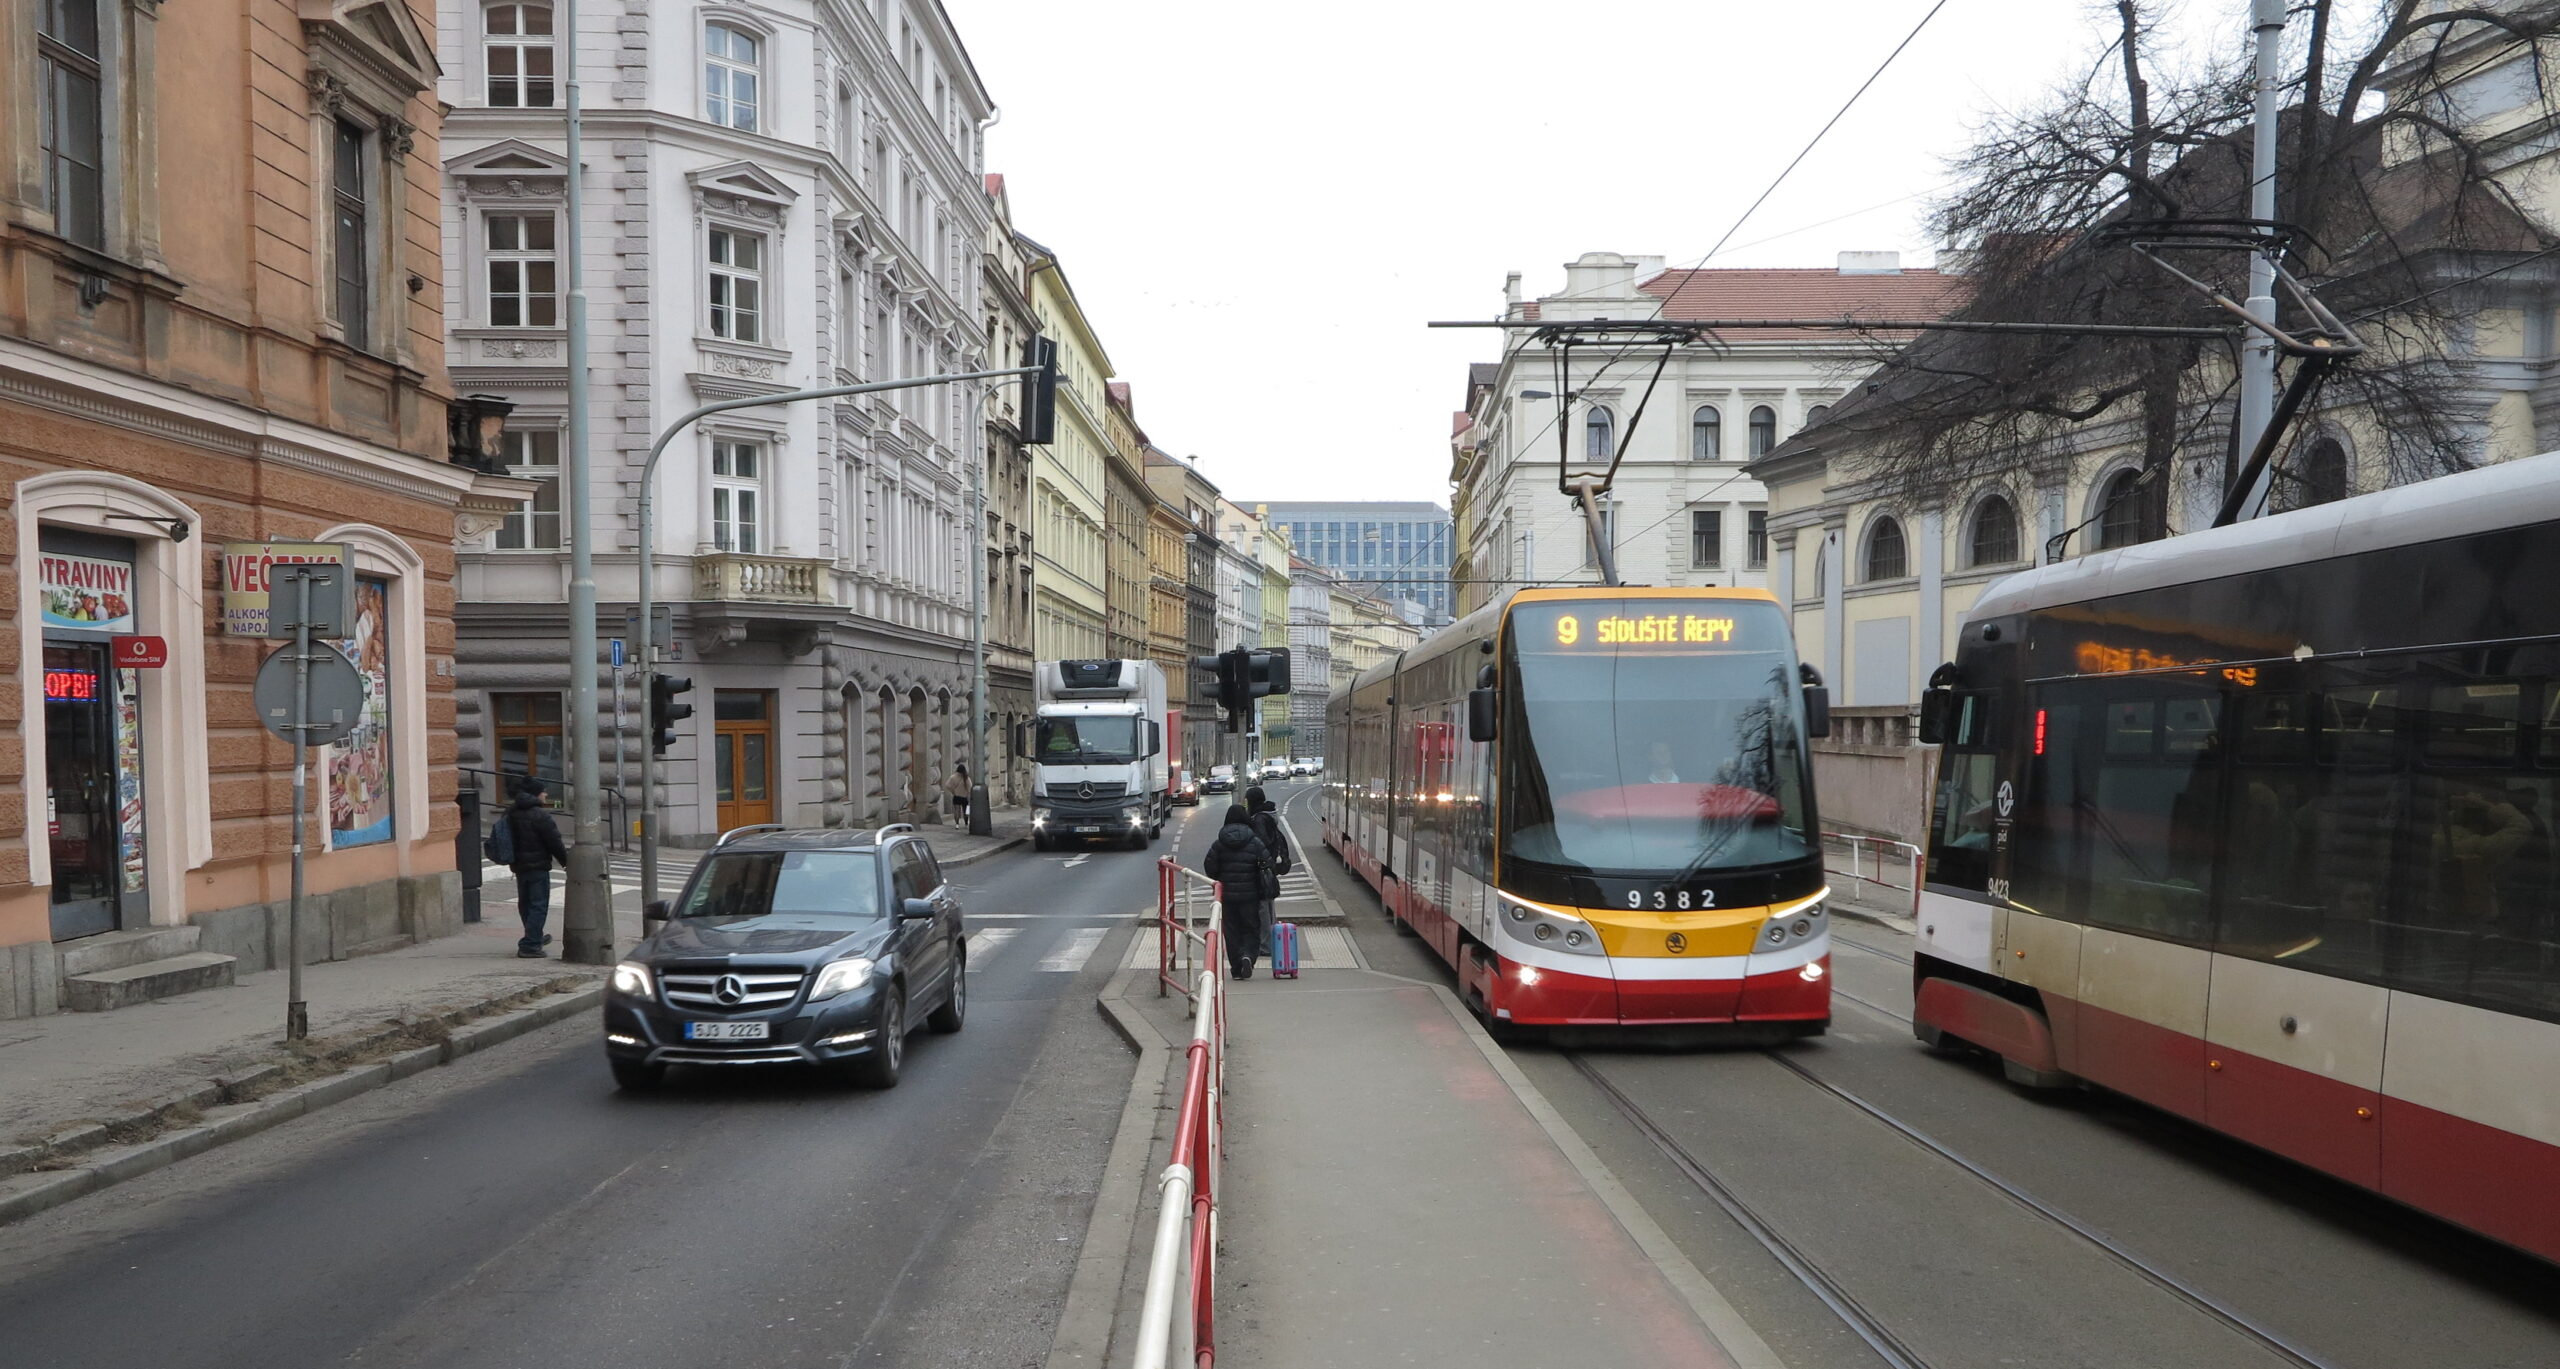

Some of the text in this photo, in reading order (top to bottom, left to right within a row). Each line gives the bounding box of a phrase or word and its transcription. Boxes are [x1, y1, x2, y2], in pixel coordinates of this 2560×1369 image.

[1557, 614, 1734, 645] 9 SÍDLIŠTĚ ŘEPY
[1627, 888, 1716, 910] 9382
[1987, 877, 2010, 900] 9423
[695, 1023, 763, 1037] 5J3 2225
